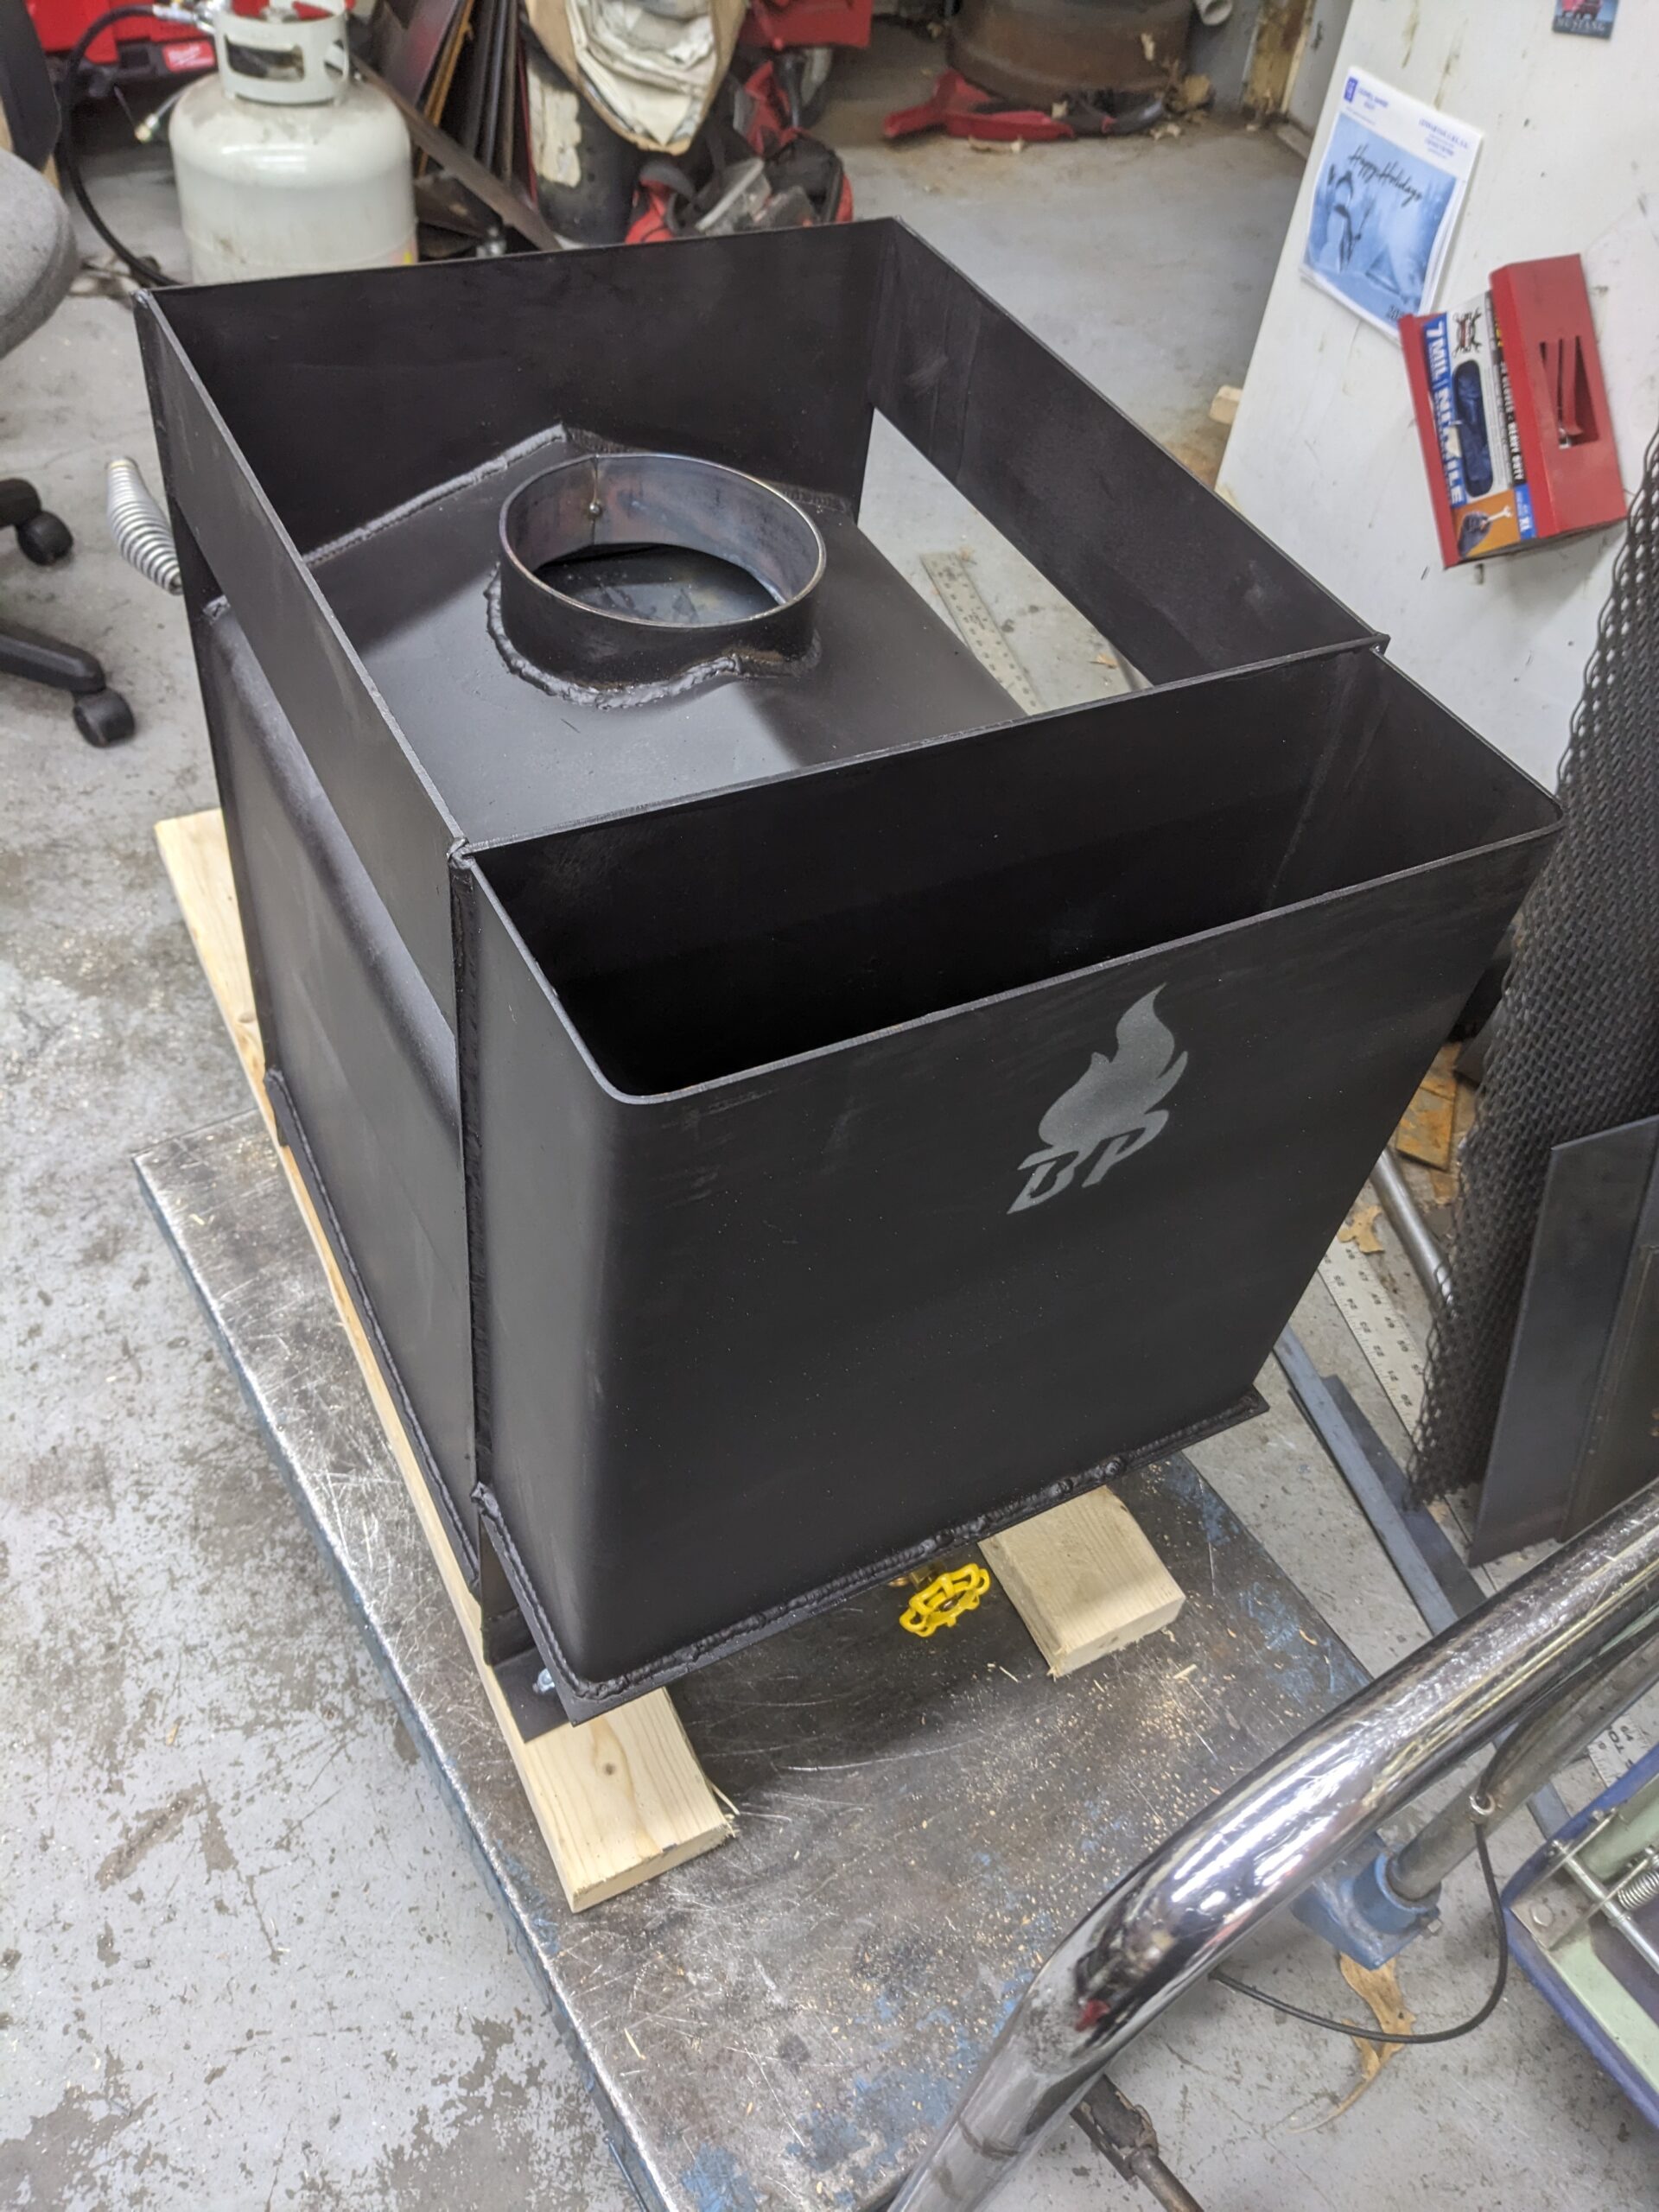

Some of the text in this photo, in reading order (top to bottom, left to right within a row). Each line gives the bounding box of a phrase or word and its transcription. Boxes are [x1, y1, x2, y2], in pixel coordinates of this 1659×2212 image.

[1348, 143, 1422, 208] Happy Holidays
[1426, 320, 1464, 505] 7 MIL NIILE
[1508, 421, 1521, 454] HEAVY
[1512, 454, 1525, 480] DUTY
